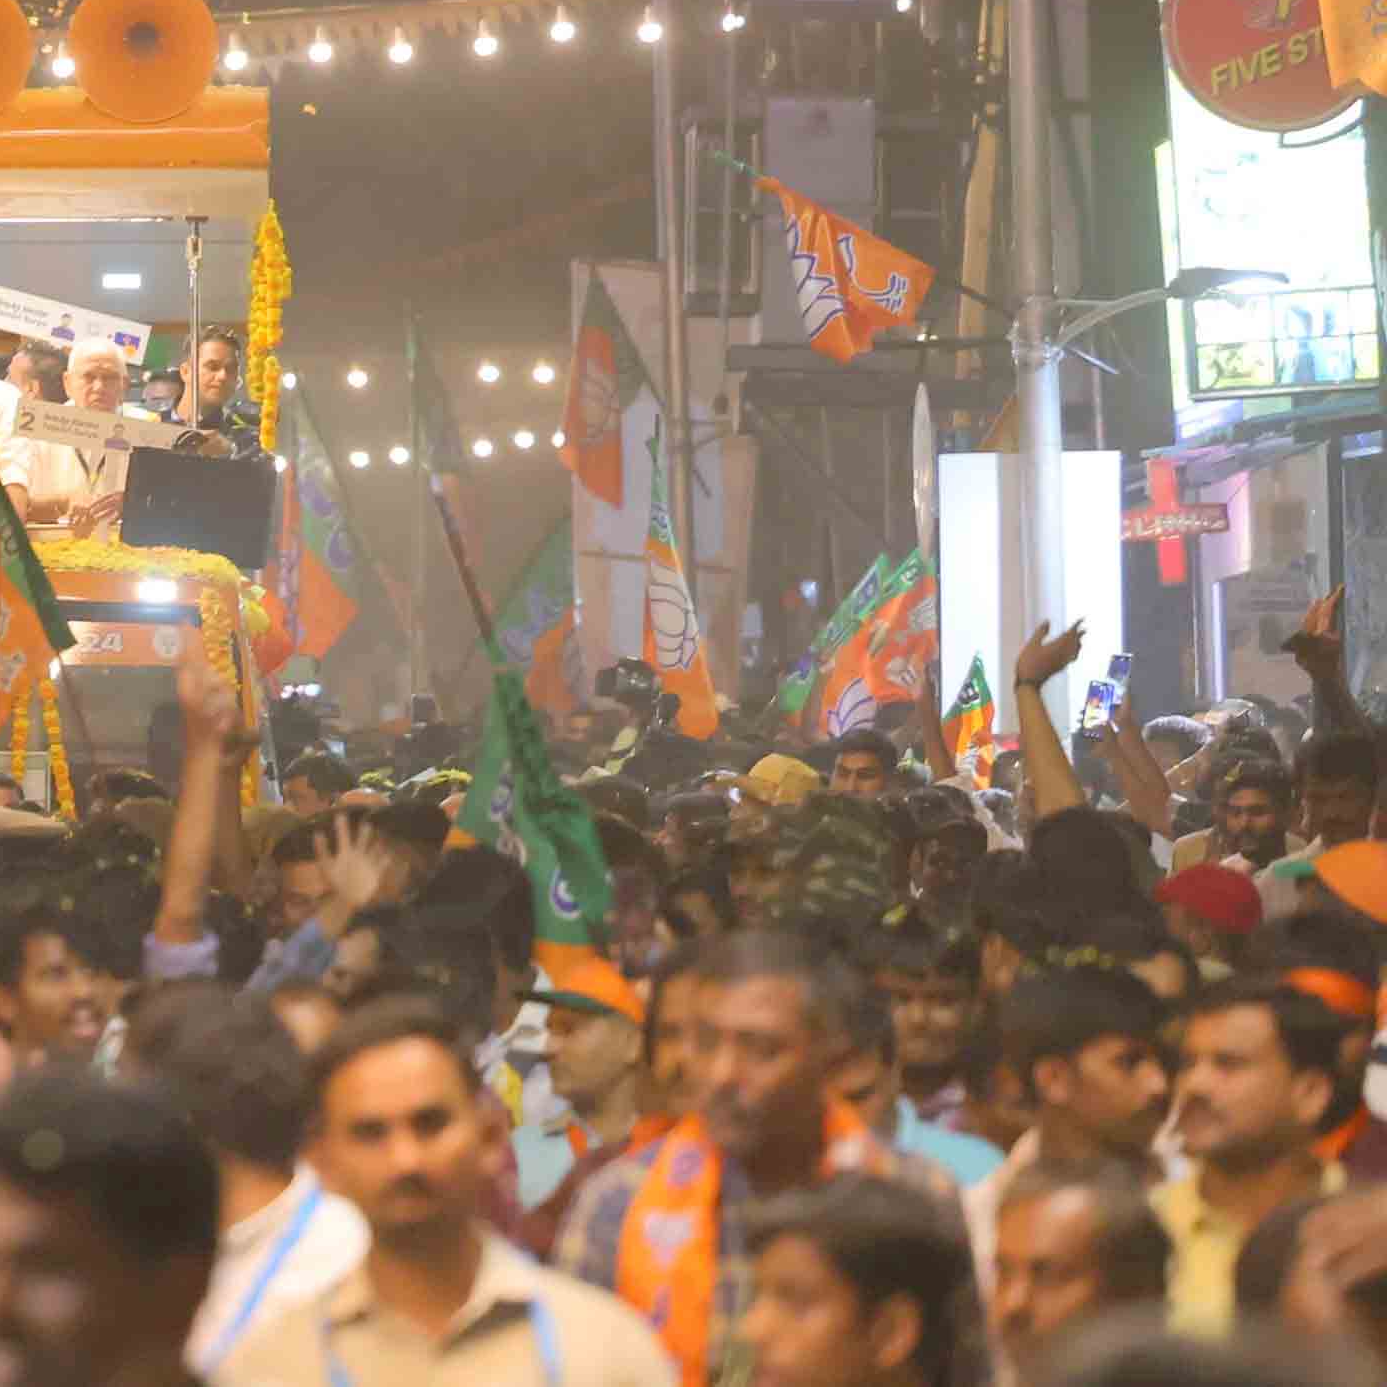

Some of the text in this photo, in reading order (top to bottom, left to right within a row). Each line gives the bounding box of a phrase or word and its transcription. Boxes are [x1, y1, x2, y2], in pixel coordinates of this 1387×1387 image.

[1210, 27, 1325, 96] FIVE ST
[18, 411, 36, 432] 2
